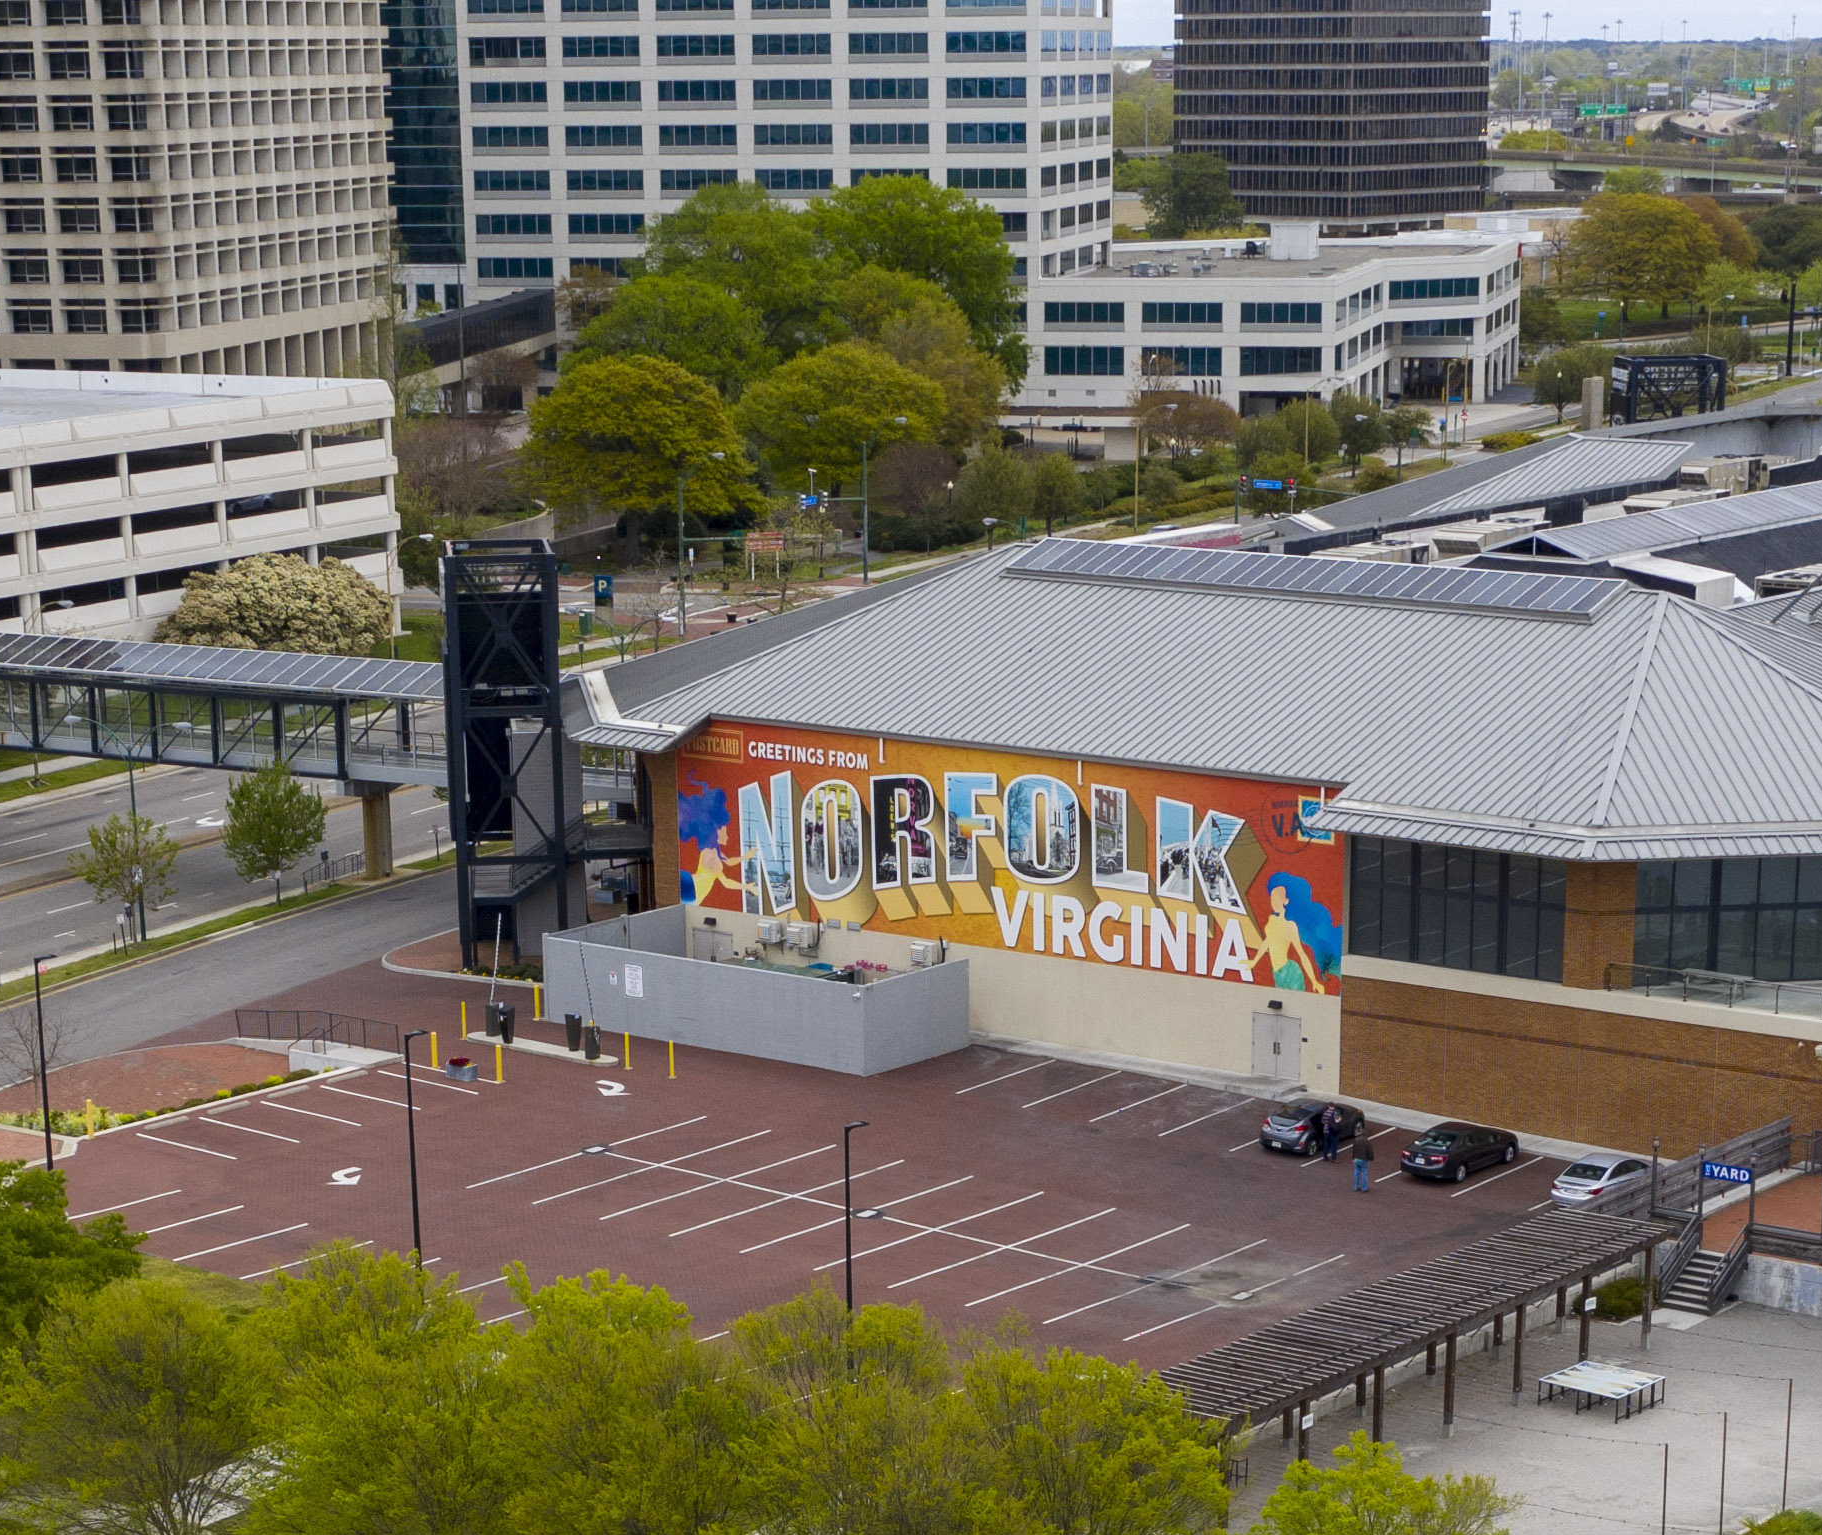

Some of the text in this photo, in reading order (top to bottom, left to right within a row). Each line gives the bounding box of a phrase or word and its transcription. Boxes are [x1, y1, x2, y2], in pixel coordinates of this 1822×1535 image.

[599, 580, 607, 592] P
[748, 741, 869, 770] GREETINGS FROM
[907, 778, 917, 841] NORVA
[738, 770, 1246, 915] NORFOLK
[991, 886, 1254, 983] VIRGINIA
[1712, 1165, 1749, 1181] YARD
